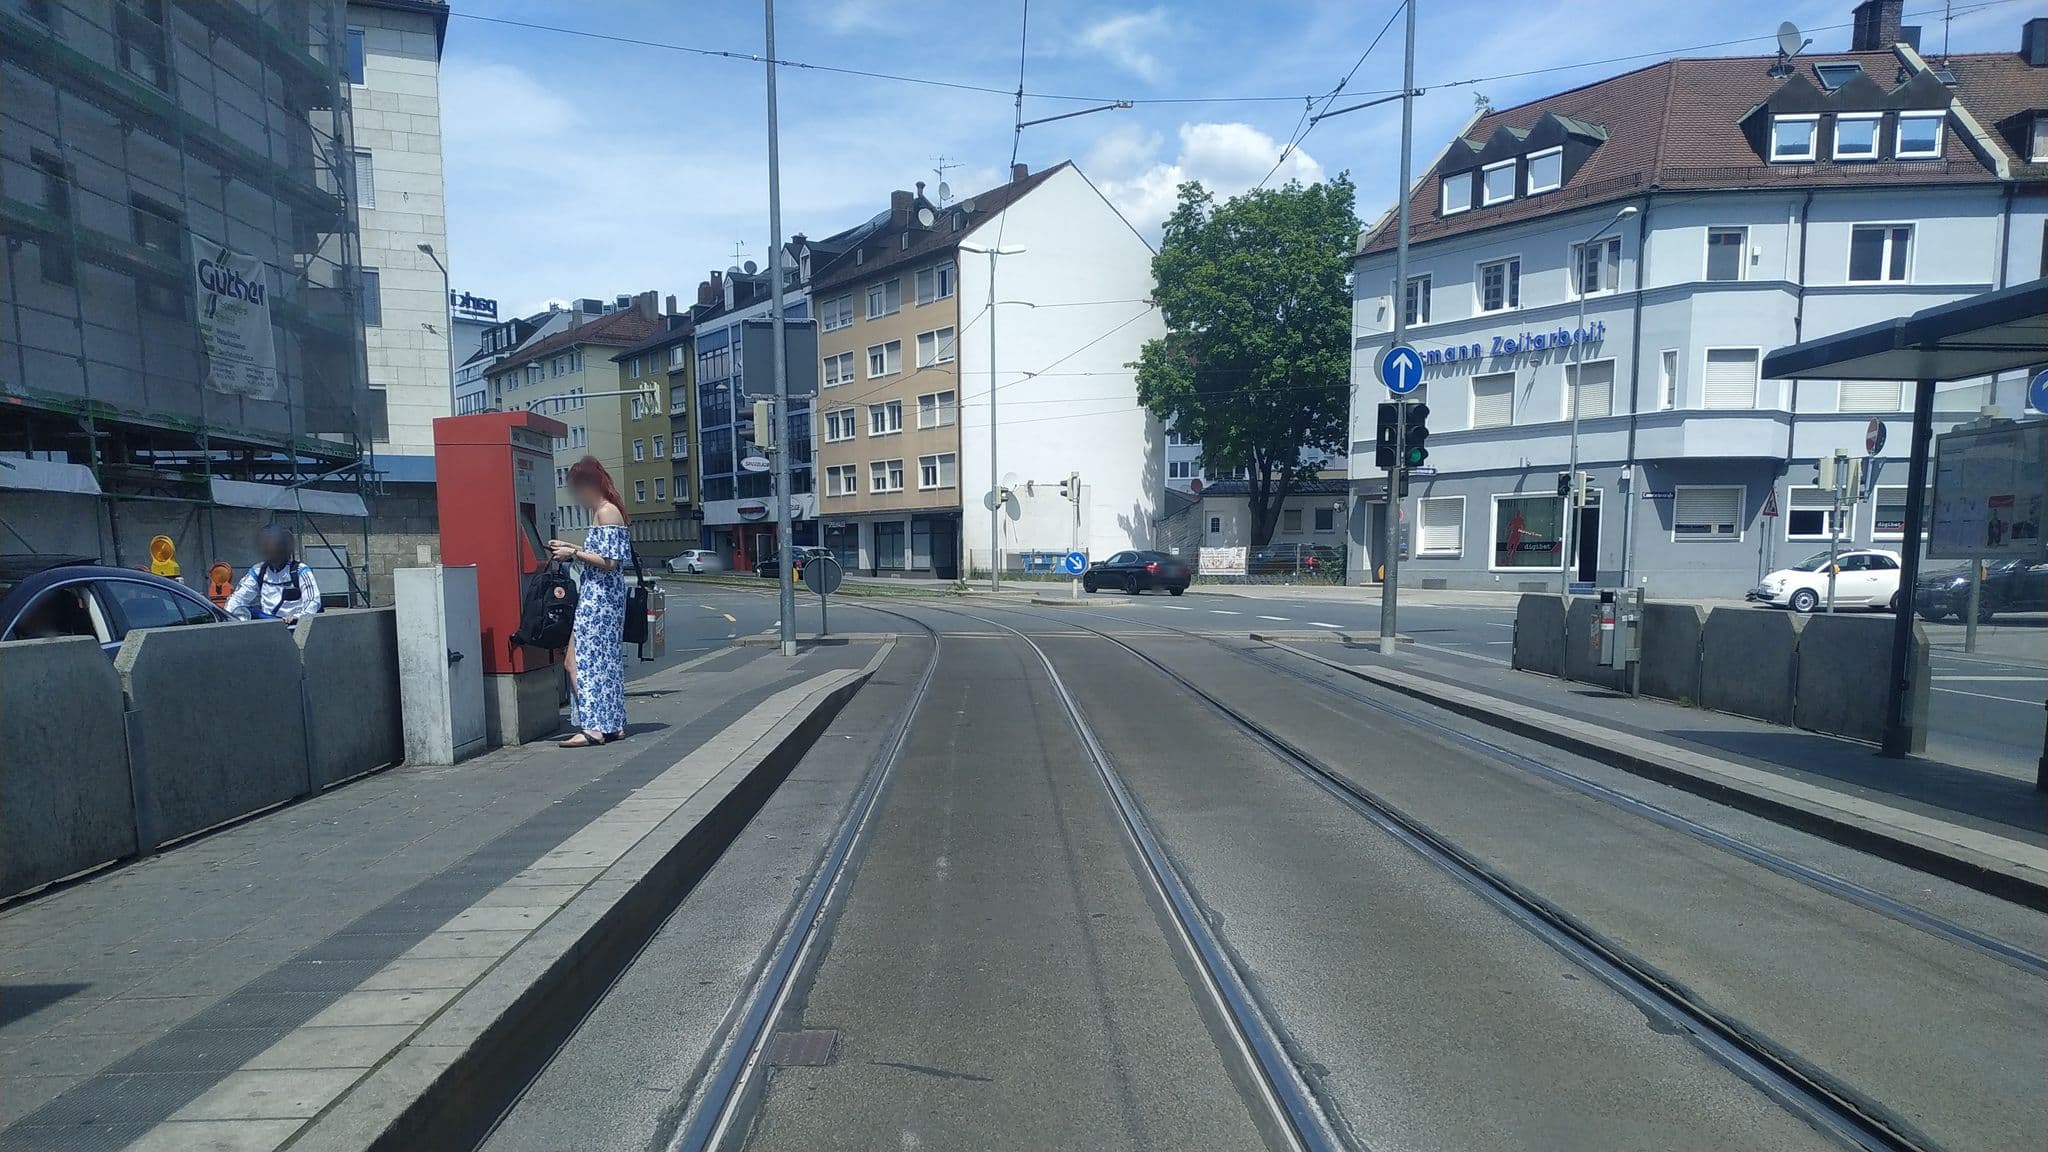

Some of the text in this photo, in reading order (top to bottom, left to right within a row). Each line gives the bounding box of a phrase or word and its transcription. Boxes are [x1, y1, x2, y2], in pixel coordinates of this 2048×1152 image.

[198, 258, 265, 306] Güther
[1419, 320, 1606, 365] mann Zeitarbeit
[1524, 543, 1552, 551] digibet
